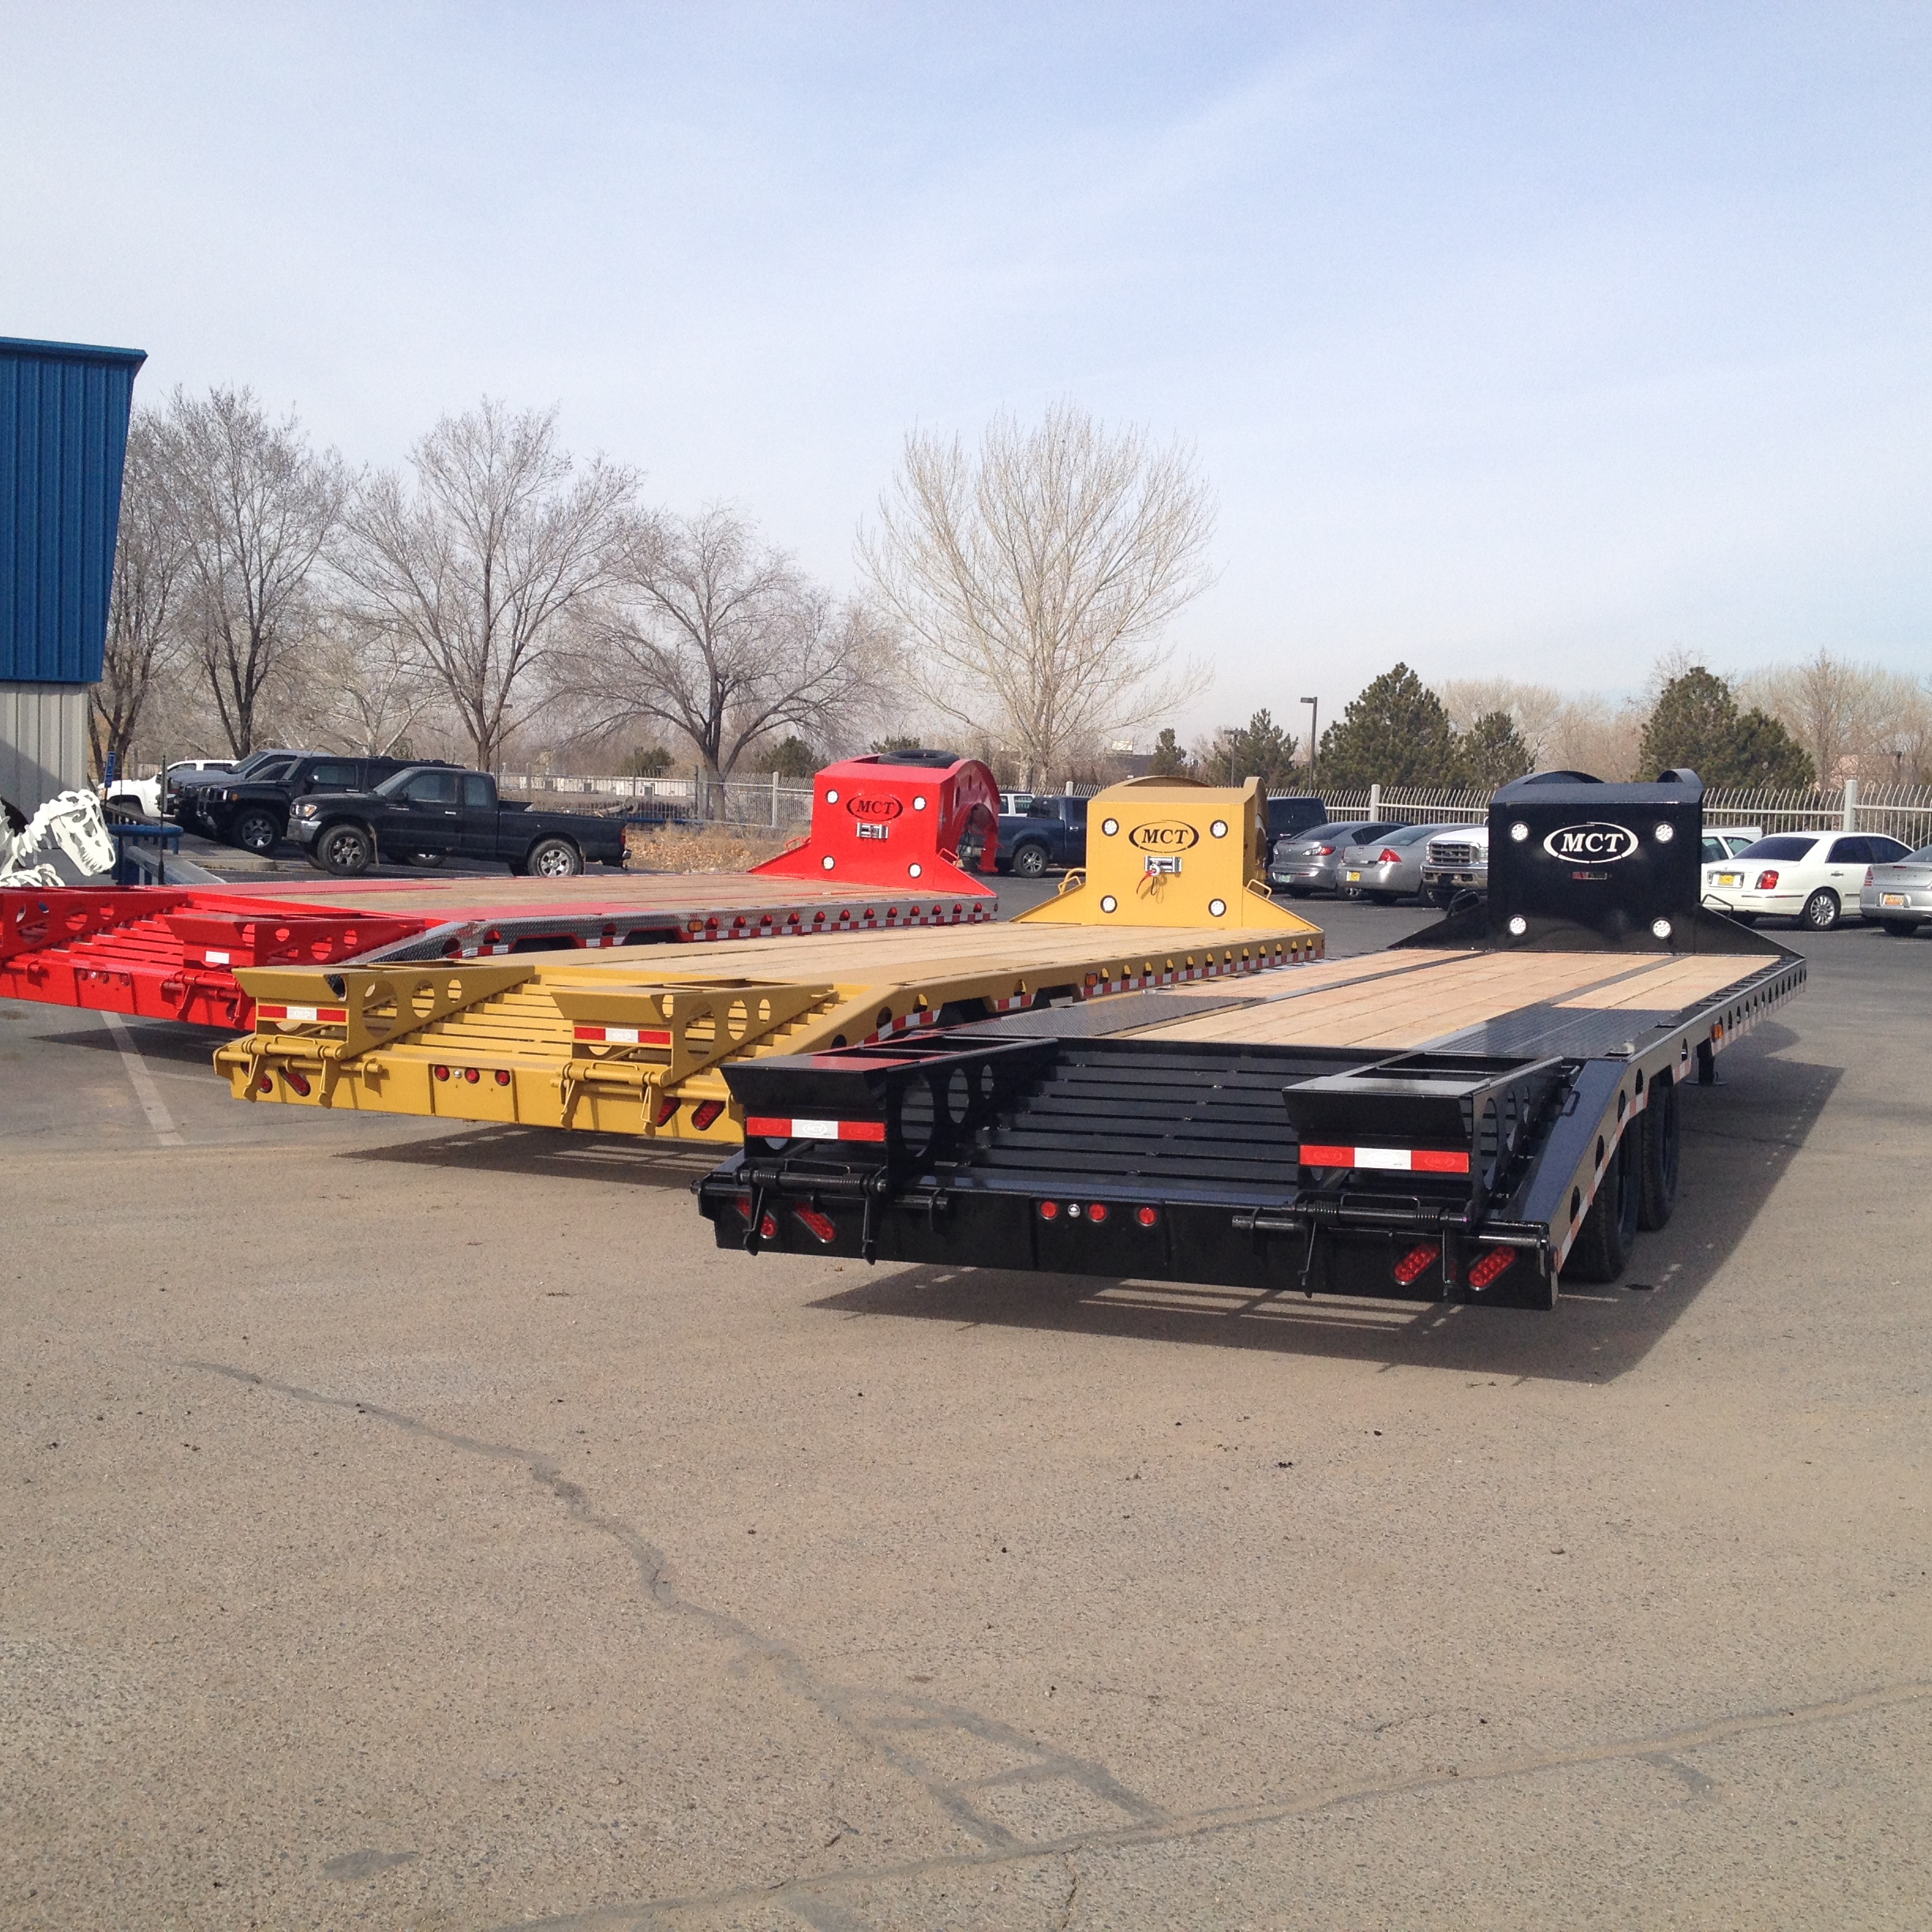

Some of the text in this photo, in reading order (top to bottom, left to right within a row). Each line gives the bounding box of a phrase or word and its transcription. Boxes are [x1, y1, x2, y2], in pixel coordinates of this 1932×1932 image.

[856, 800, 895, 815] MCT
[1140, 829, 1189, 844] MCT
[1560, 833, 1624, 852] MCT
